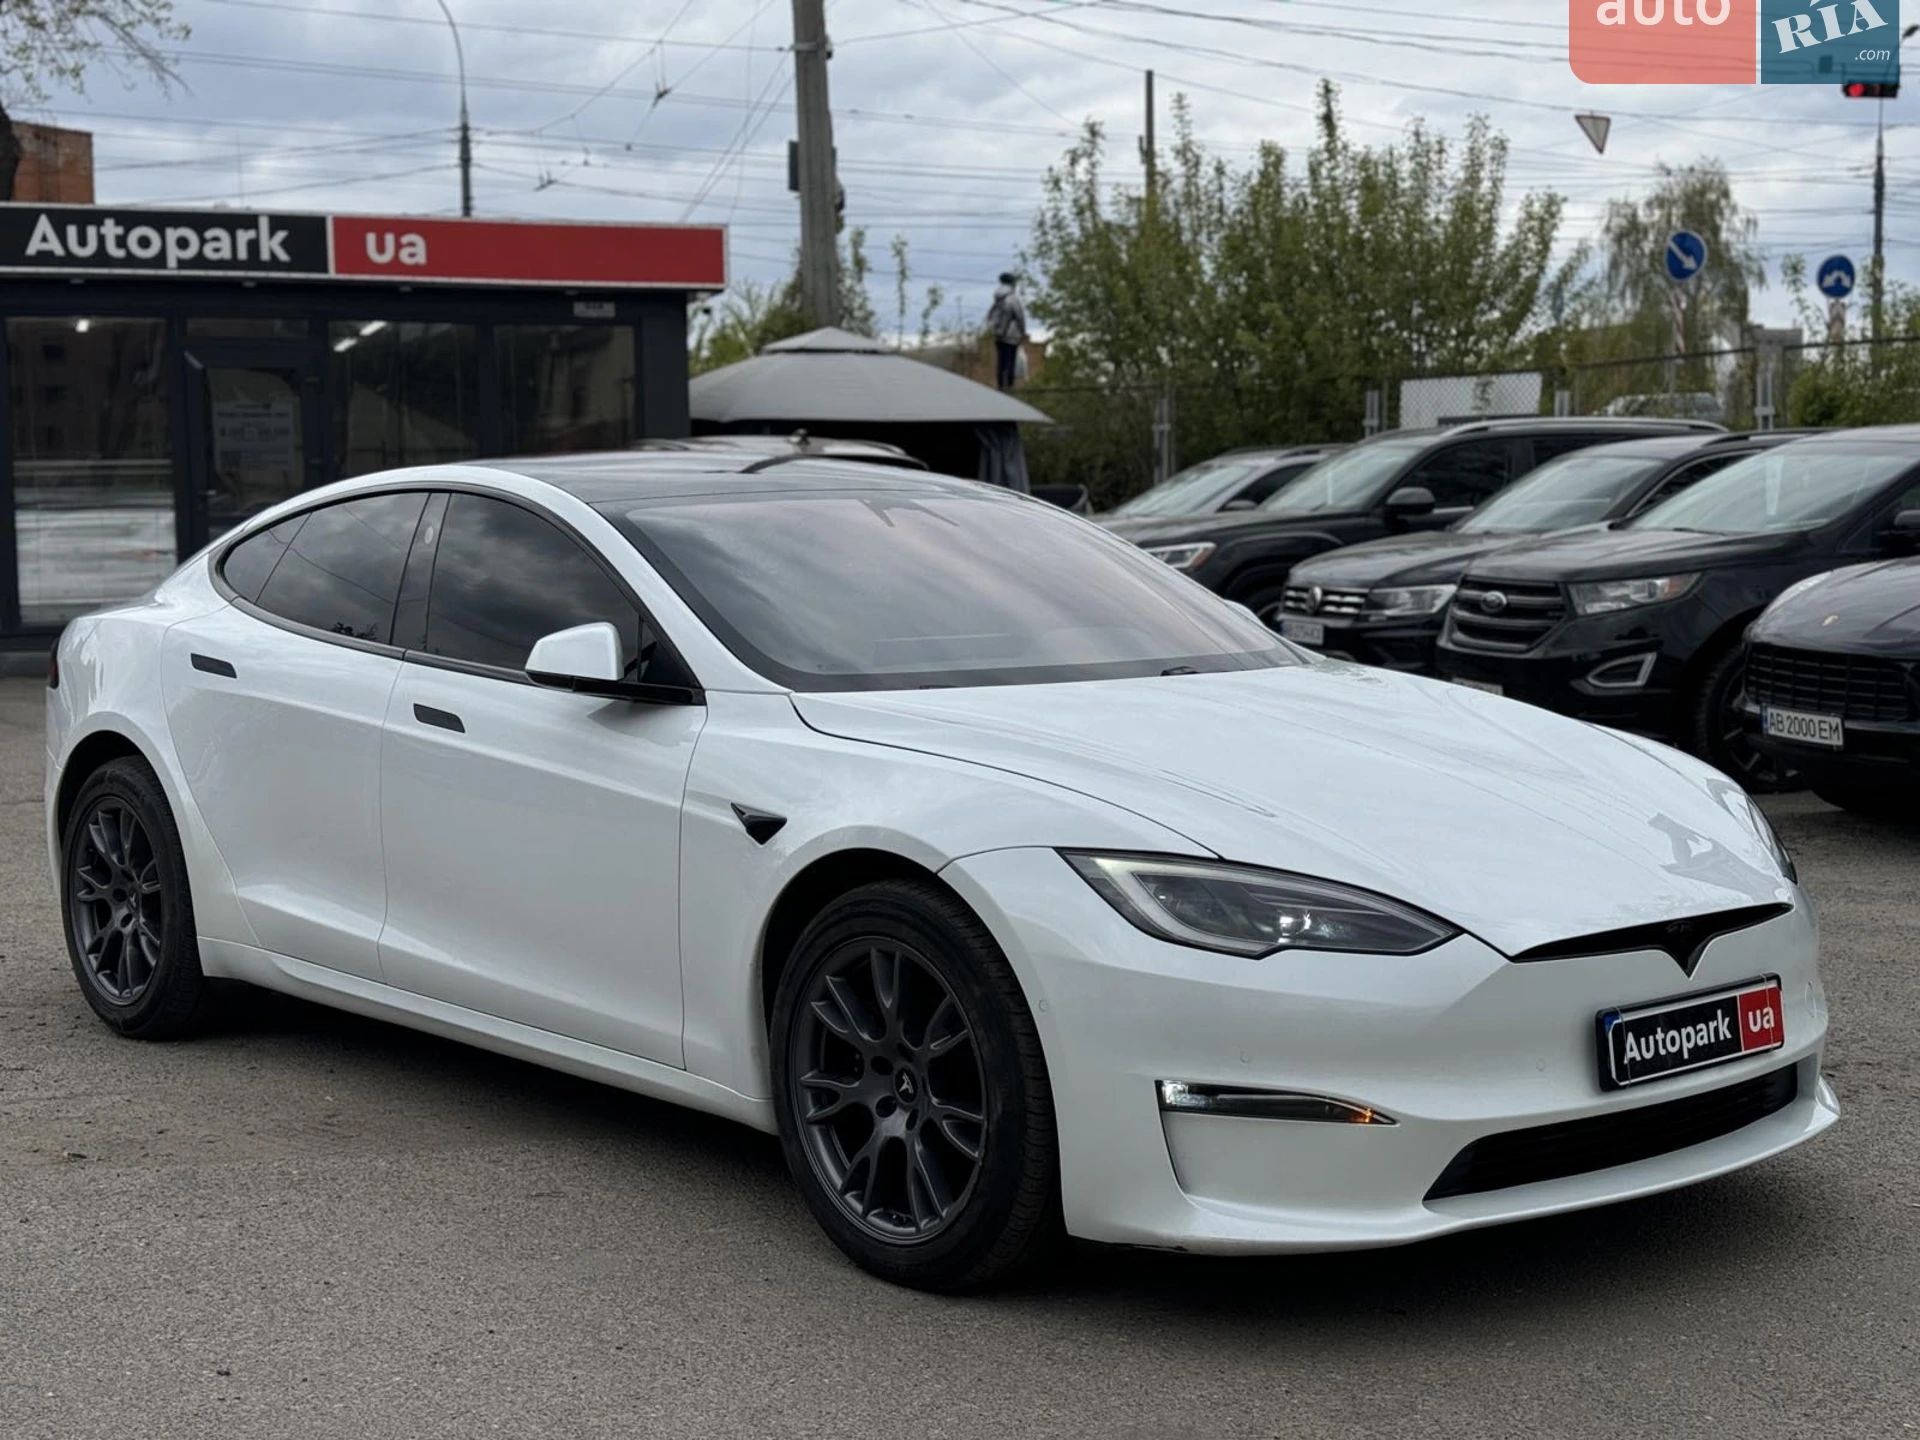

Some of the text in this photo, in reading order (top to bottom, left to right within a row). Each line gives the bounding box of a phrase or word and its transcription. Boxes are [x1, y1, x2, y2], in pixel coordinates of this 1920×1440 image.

[25, 213, 428, 269] Autopark ua
[1769, 711, 1841, 740] AB 2000 EM
[1623, 1006, 1775, 1064] Autopark ua
